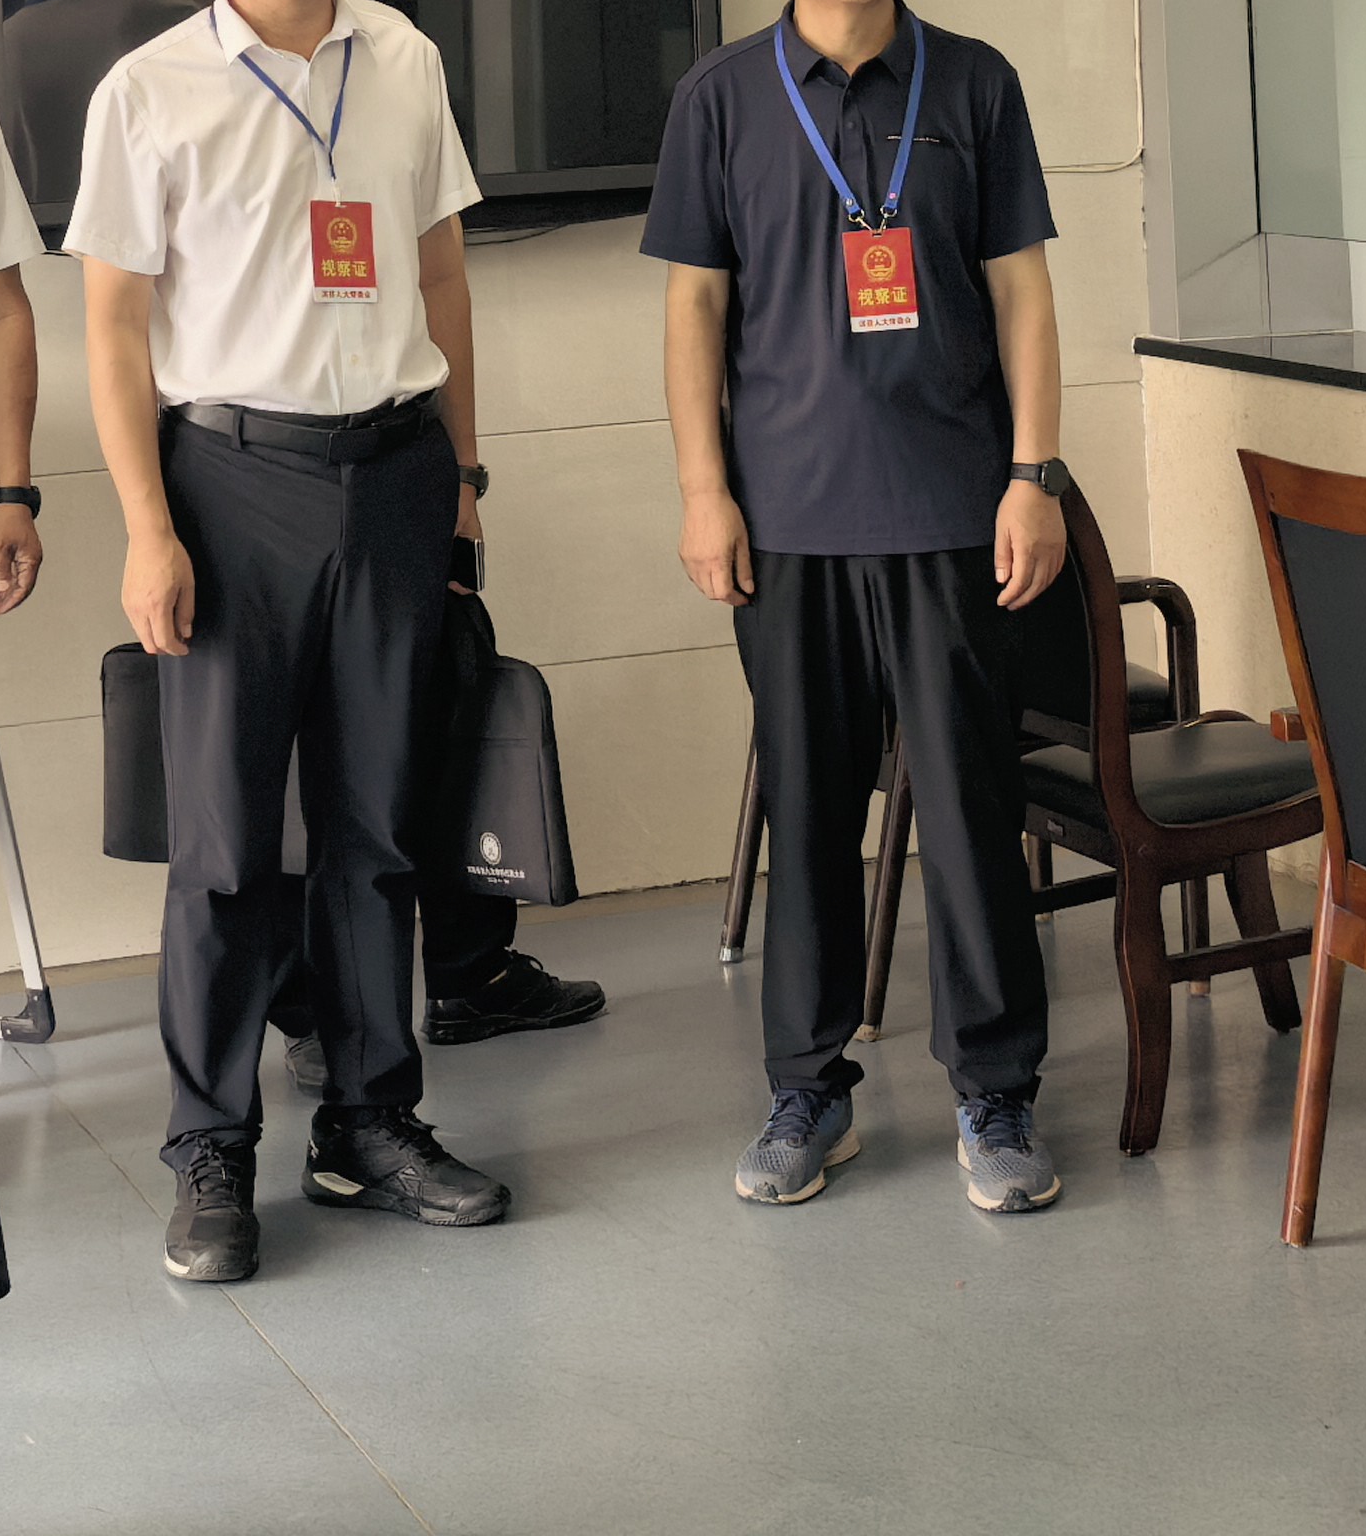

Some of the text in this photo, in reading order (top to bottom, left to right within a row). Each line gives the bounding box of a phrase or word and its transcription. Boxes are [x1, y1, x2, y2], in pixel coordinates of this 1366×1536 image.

[321, 259, 368, 278] 视察证
[857, 286, 907, 307] 视察证
